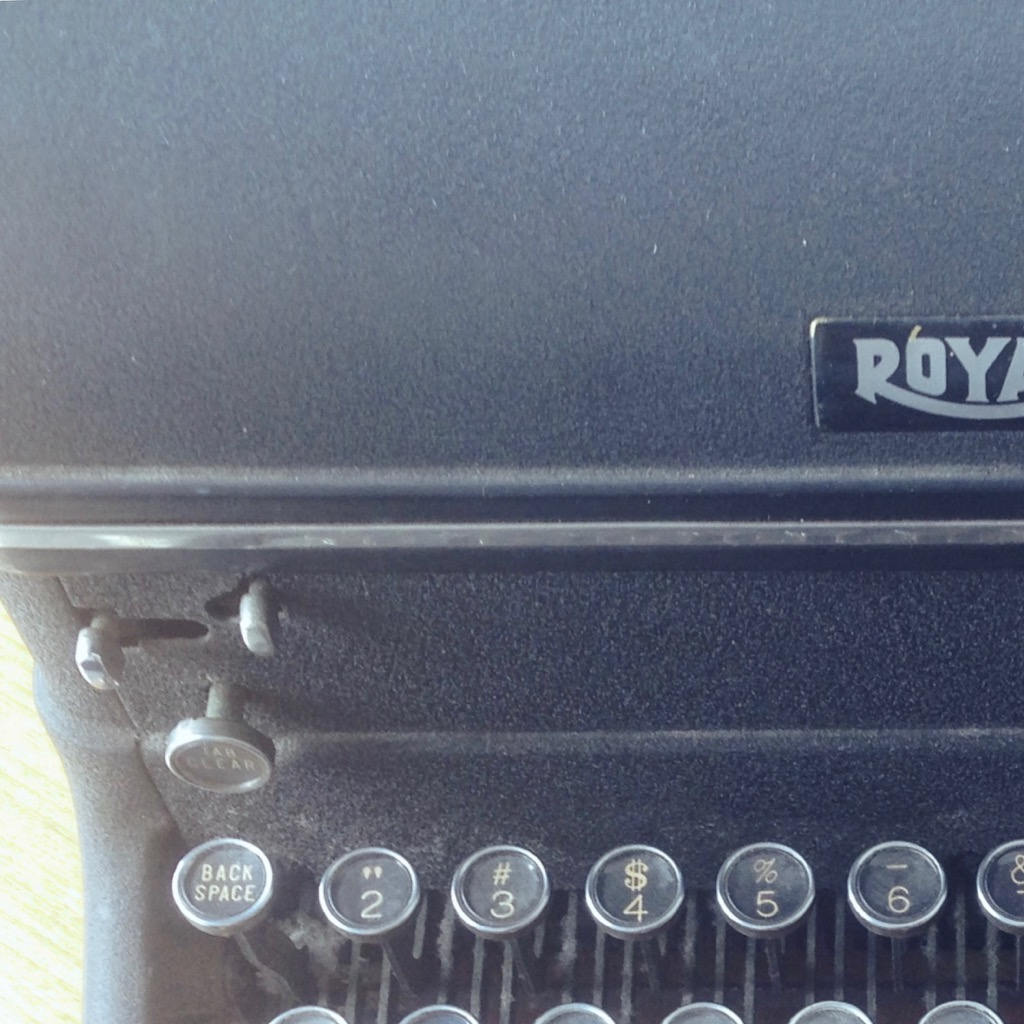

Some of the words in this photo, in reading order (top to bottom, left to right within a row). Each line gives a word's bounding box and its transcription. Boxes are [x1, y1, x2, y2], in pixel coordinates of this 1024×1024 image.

[201, 863, 255, 882] BACK
[492, 861, 512, 886] #
[624, 858, 649, 892] $
[754, 858, 778, 884] %
[193, 884, 256, 902] SPACE
[360, 889, 383, 919] 2
[490, 889, 515, 919] 3
[756, 890, 779, 917] 5
[887, 885, 911, 914] 6
[623, 893, 650, 923] 4
